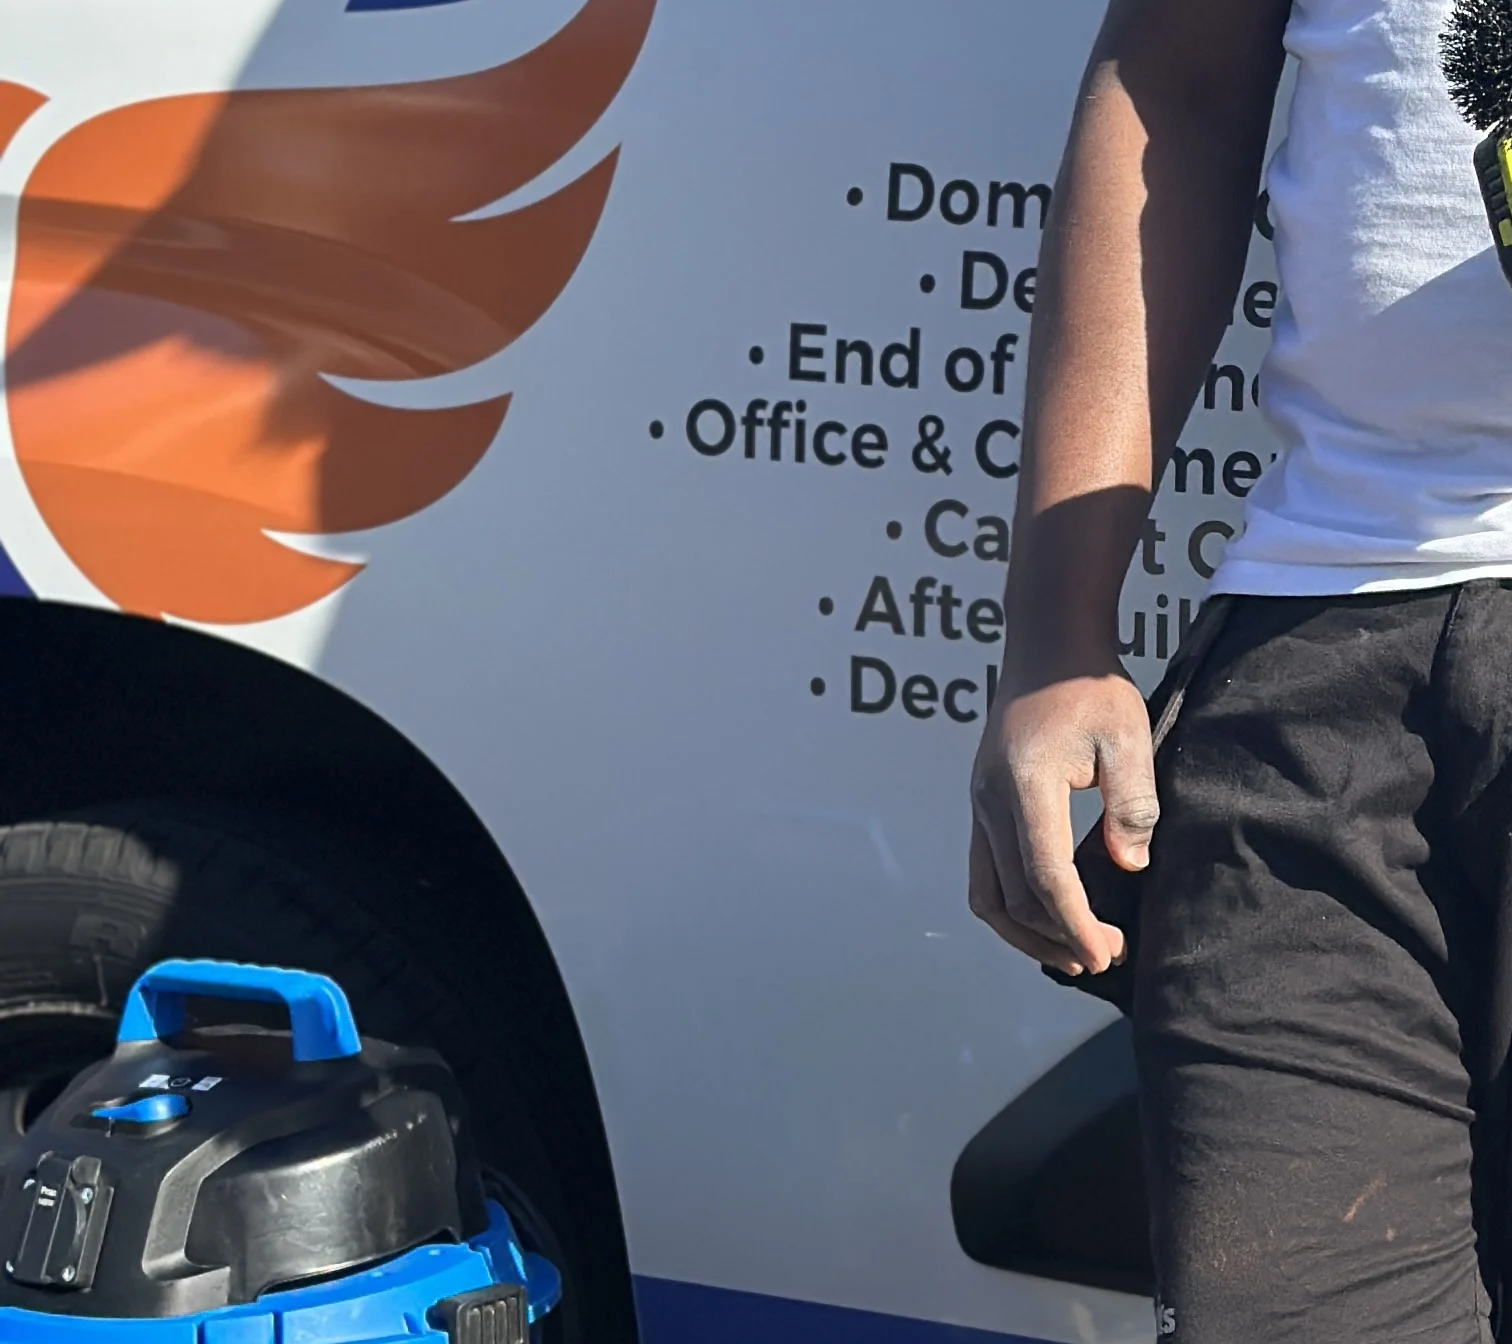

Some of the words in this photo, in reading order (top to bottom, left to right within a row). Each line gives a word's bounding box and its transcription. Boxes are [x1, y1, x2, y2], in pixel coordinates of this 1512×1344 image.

[788, 323, 921, 394] End
[944, 333, 1019, 396] of
[685, 398, 889, 469] Office
[911, 413, 954, 475] &
[854, 576, 1004, 644] Afte
